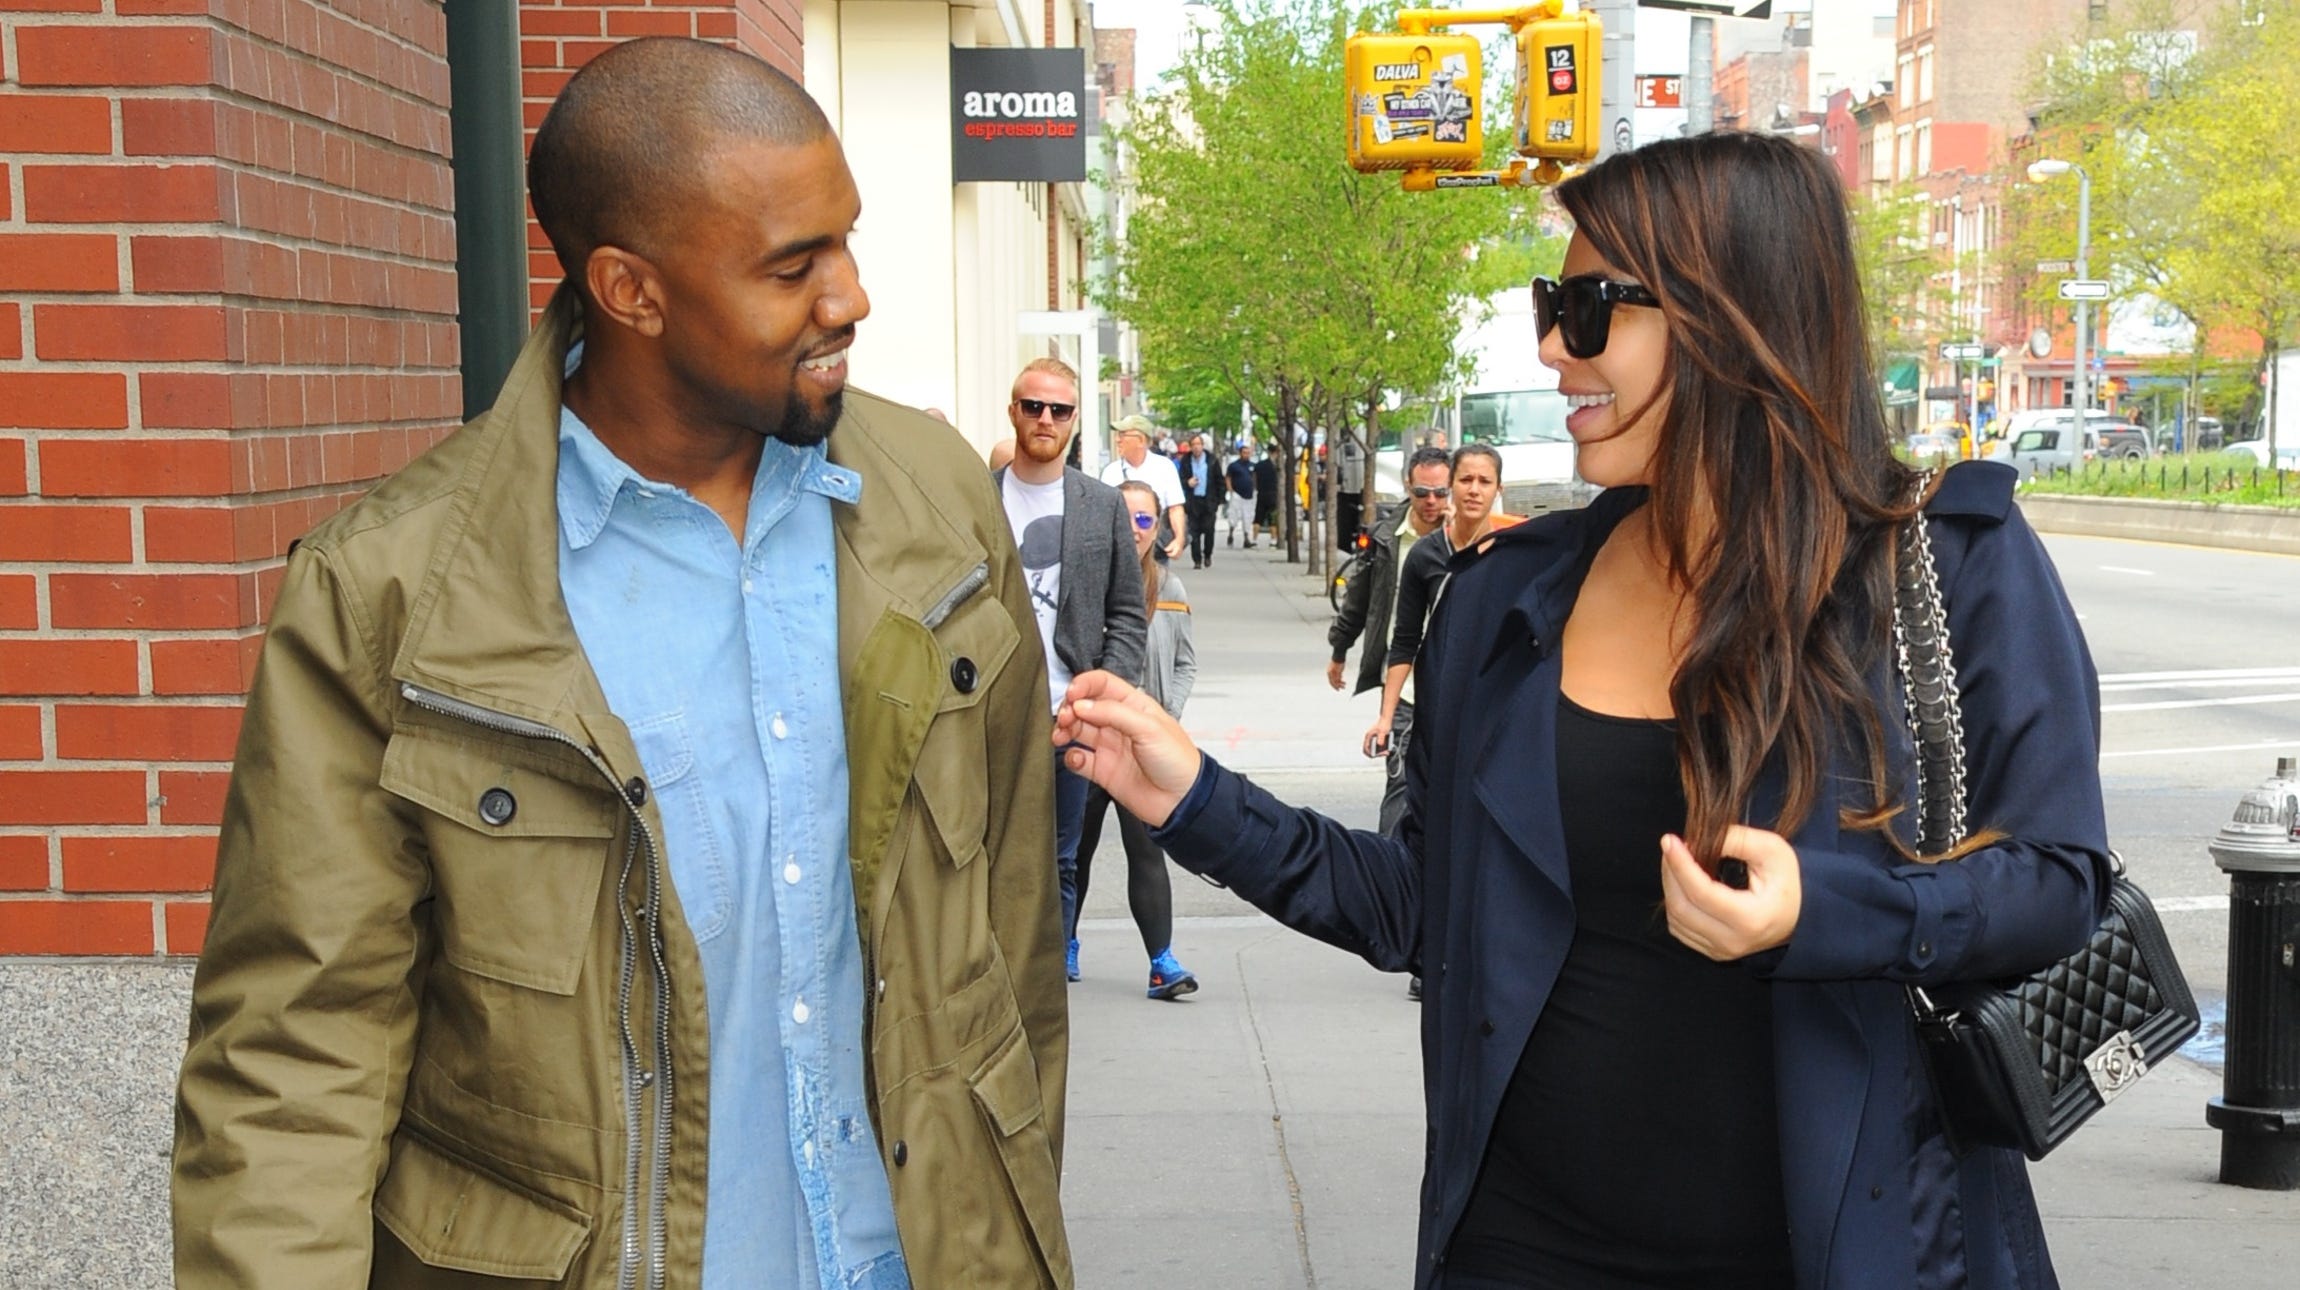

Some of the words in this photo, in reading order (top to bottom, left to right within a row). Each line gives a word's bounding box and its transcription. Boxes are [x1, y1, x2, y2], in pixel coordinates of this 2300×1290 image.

[1550, 49, 1571, 68] 12
[1375, 64, 1419, 81] DALVA
[1664, 79, 1681, 95] ST
[963, 91, 1078, 118] aroma
[964, 122, 1045, 141] espresso
[1045, 118, 1077, 138] bar
